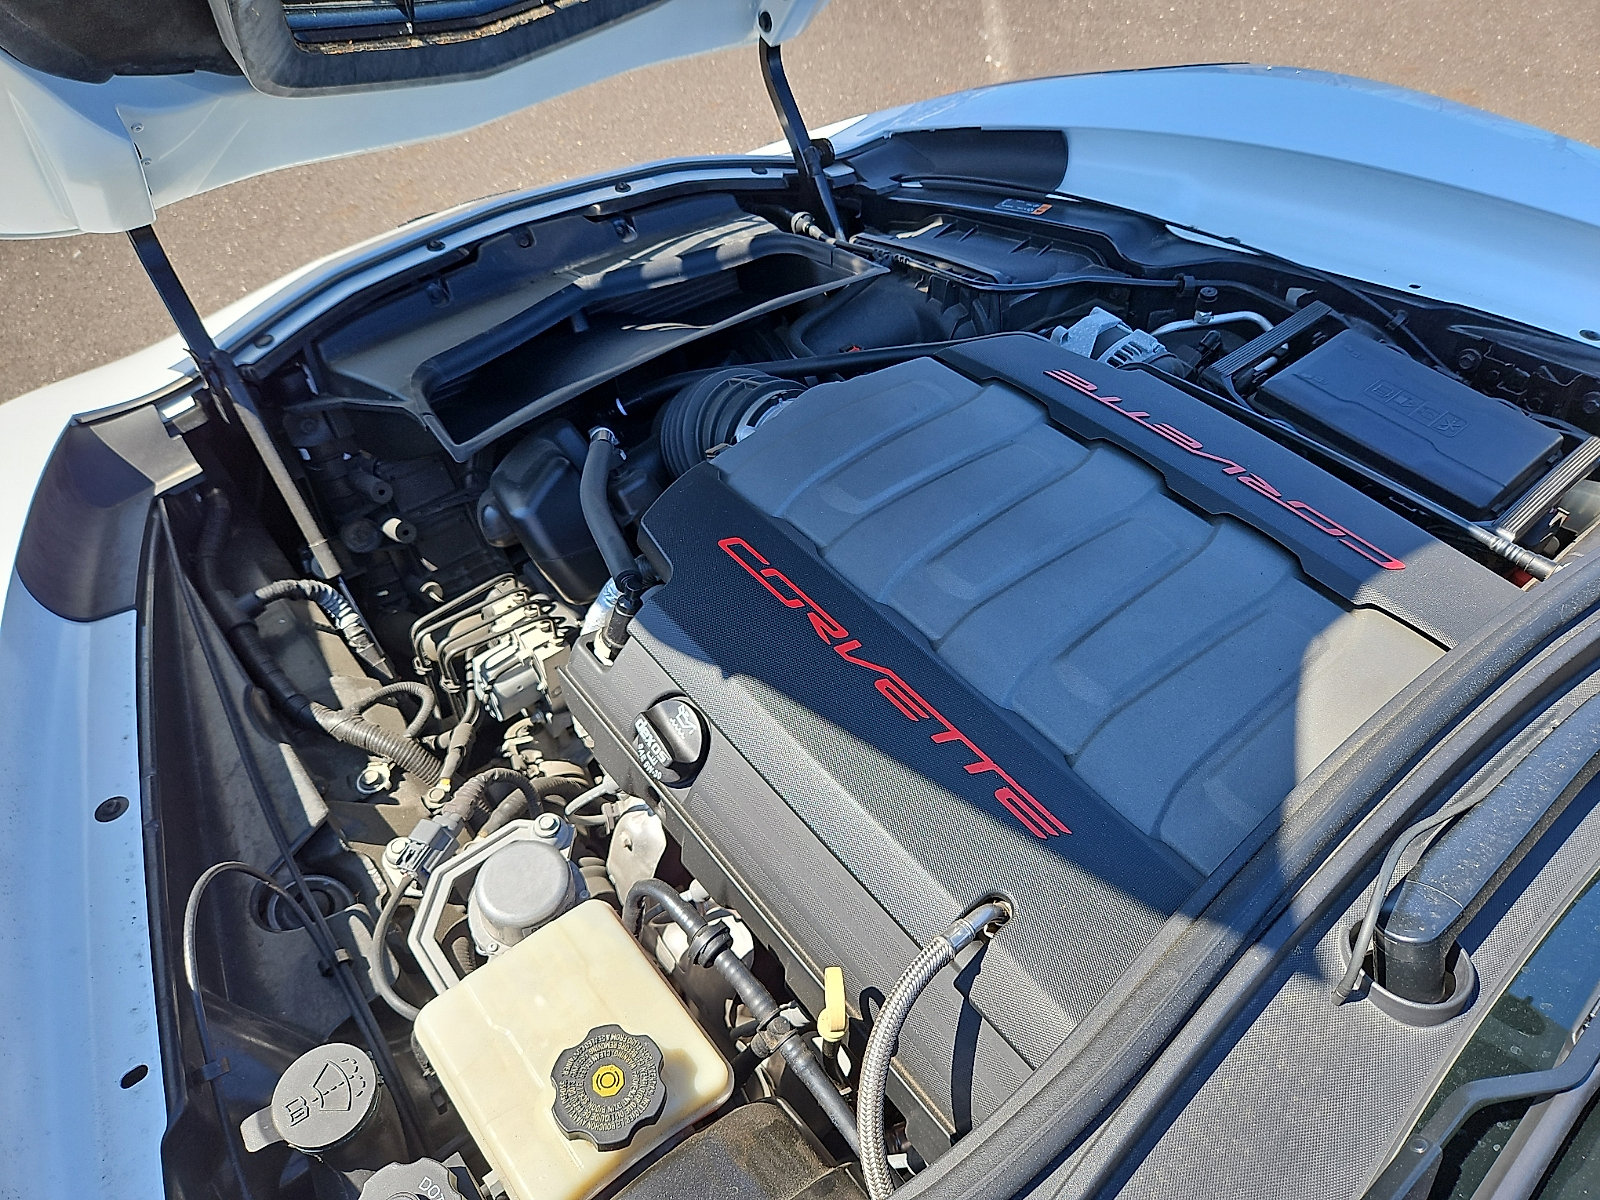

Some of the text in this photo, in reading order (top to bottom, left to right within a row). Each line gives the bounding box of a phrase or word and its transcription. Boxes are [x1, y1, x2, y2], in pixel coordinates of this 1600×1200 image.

[1043, 369, 1406, 570] CORVETTE
[718, 537, 1072, 839] CORVETTE
[635, 718, 671, 764] dexos
[610, 1034, 628, 1042] FROM
[590, 1050, 611, 1062] CLEAN
[586, 1120, 616, 1132] BOUCHON
